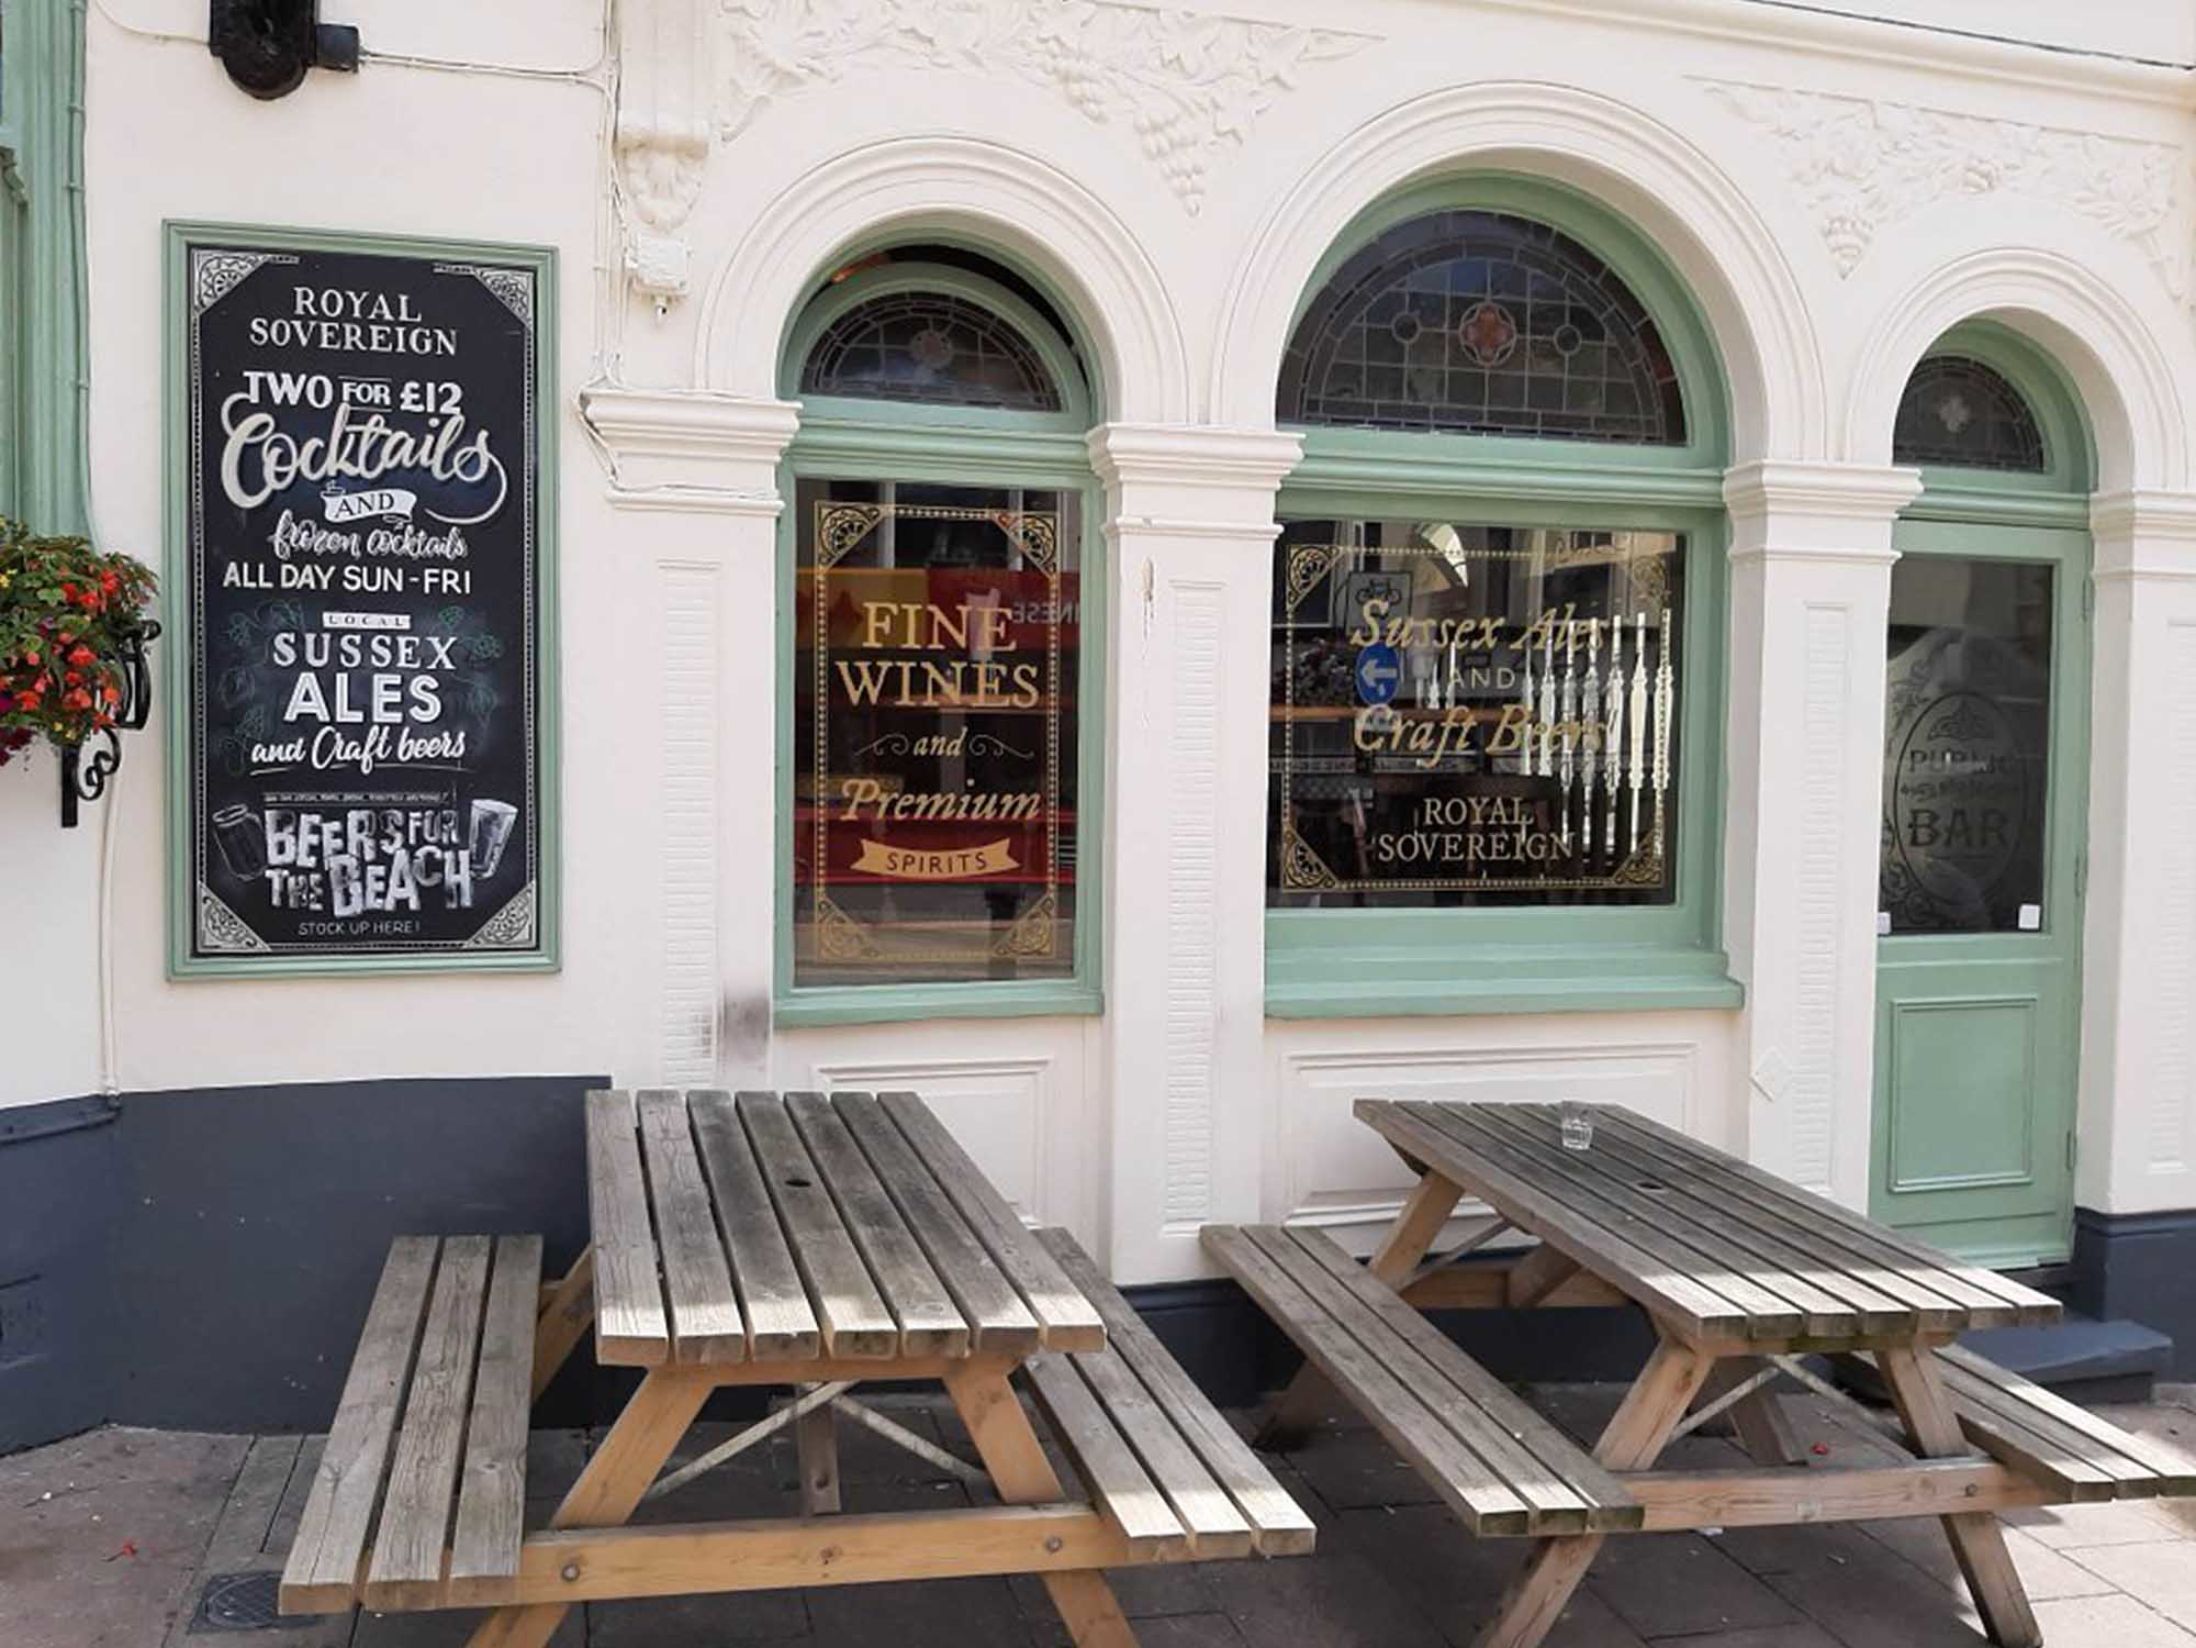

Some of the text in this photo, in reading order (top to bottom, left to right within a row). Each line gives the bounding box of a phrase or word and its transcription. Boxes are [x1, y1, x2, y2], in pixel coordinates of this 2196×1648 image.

[294, 287, 422, 322] ROYAL
[249, 318, 458, 356] SOVEREIGN
[243, 370, 463, 414] TWO FOR £12
[220, 393, 508, 525] Cocktails
[334, 492, 395, 517] AND
[268, 509, 361, 561] frozen
[222, 561, 273, 588] ALL
[280, 564, 336, 590] DAY
[862, 602, 1017, 651] FINE
[1350, 599, 1505, 650] Sussex
[272, 632, 458, 669] SUSSEX
[283, 672, 442, 723] ALES
[836, 661, 1039, 708] WINES
[1450, 667, 1516, 689] AND
[251, 726, 466, 775] and Craft beers
[912, 726, 968, 757] and
[1354, 703, 1477, 768] Craft
[840, 778, 1041, 822] Premium
[1424, 798, 1534, 826] ROYAL
[265, 809, 404, 871] BEERS
[1378, 833, 1575, 862] SOVEREIGN
[1909, 808, 2008, 848] BAR
[265, 845, 472, 917] THE BEACH
[885, 851, 987, 873] SPIRITS
[298, 921, 345, 936] STOCK
[349, 922, 371, 934] UP
